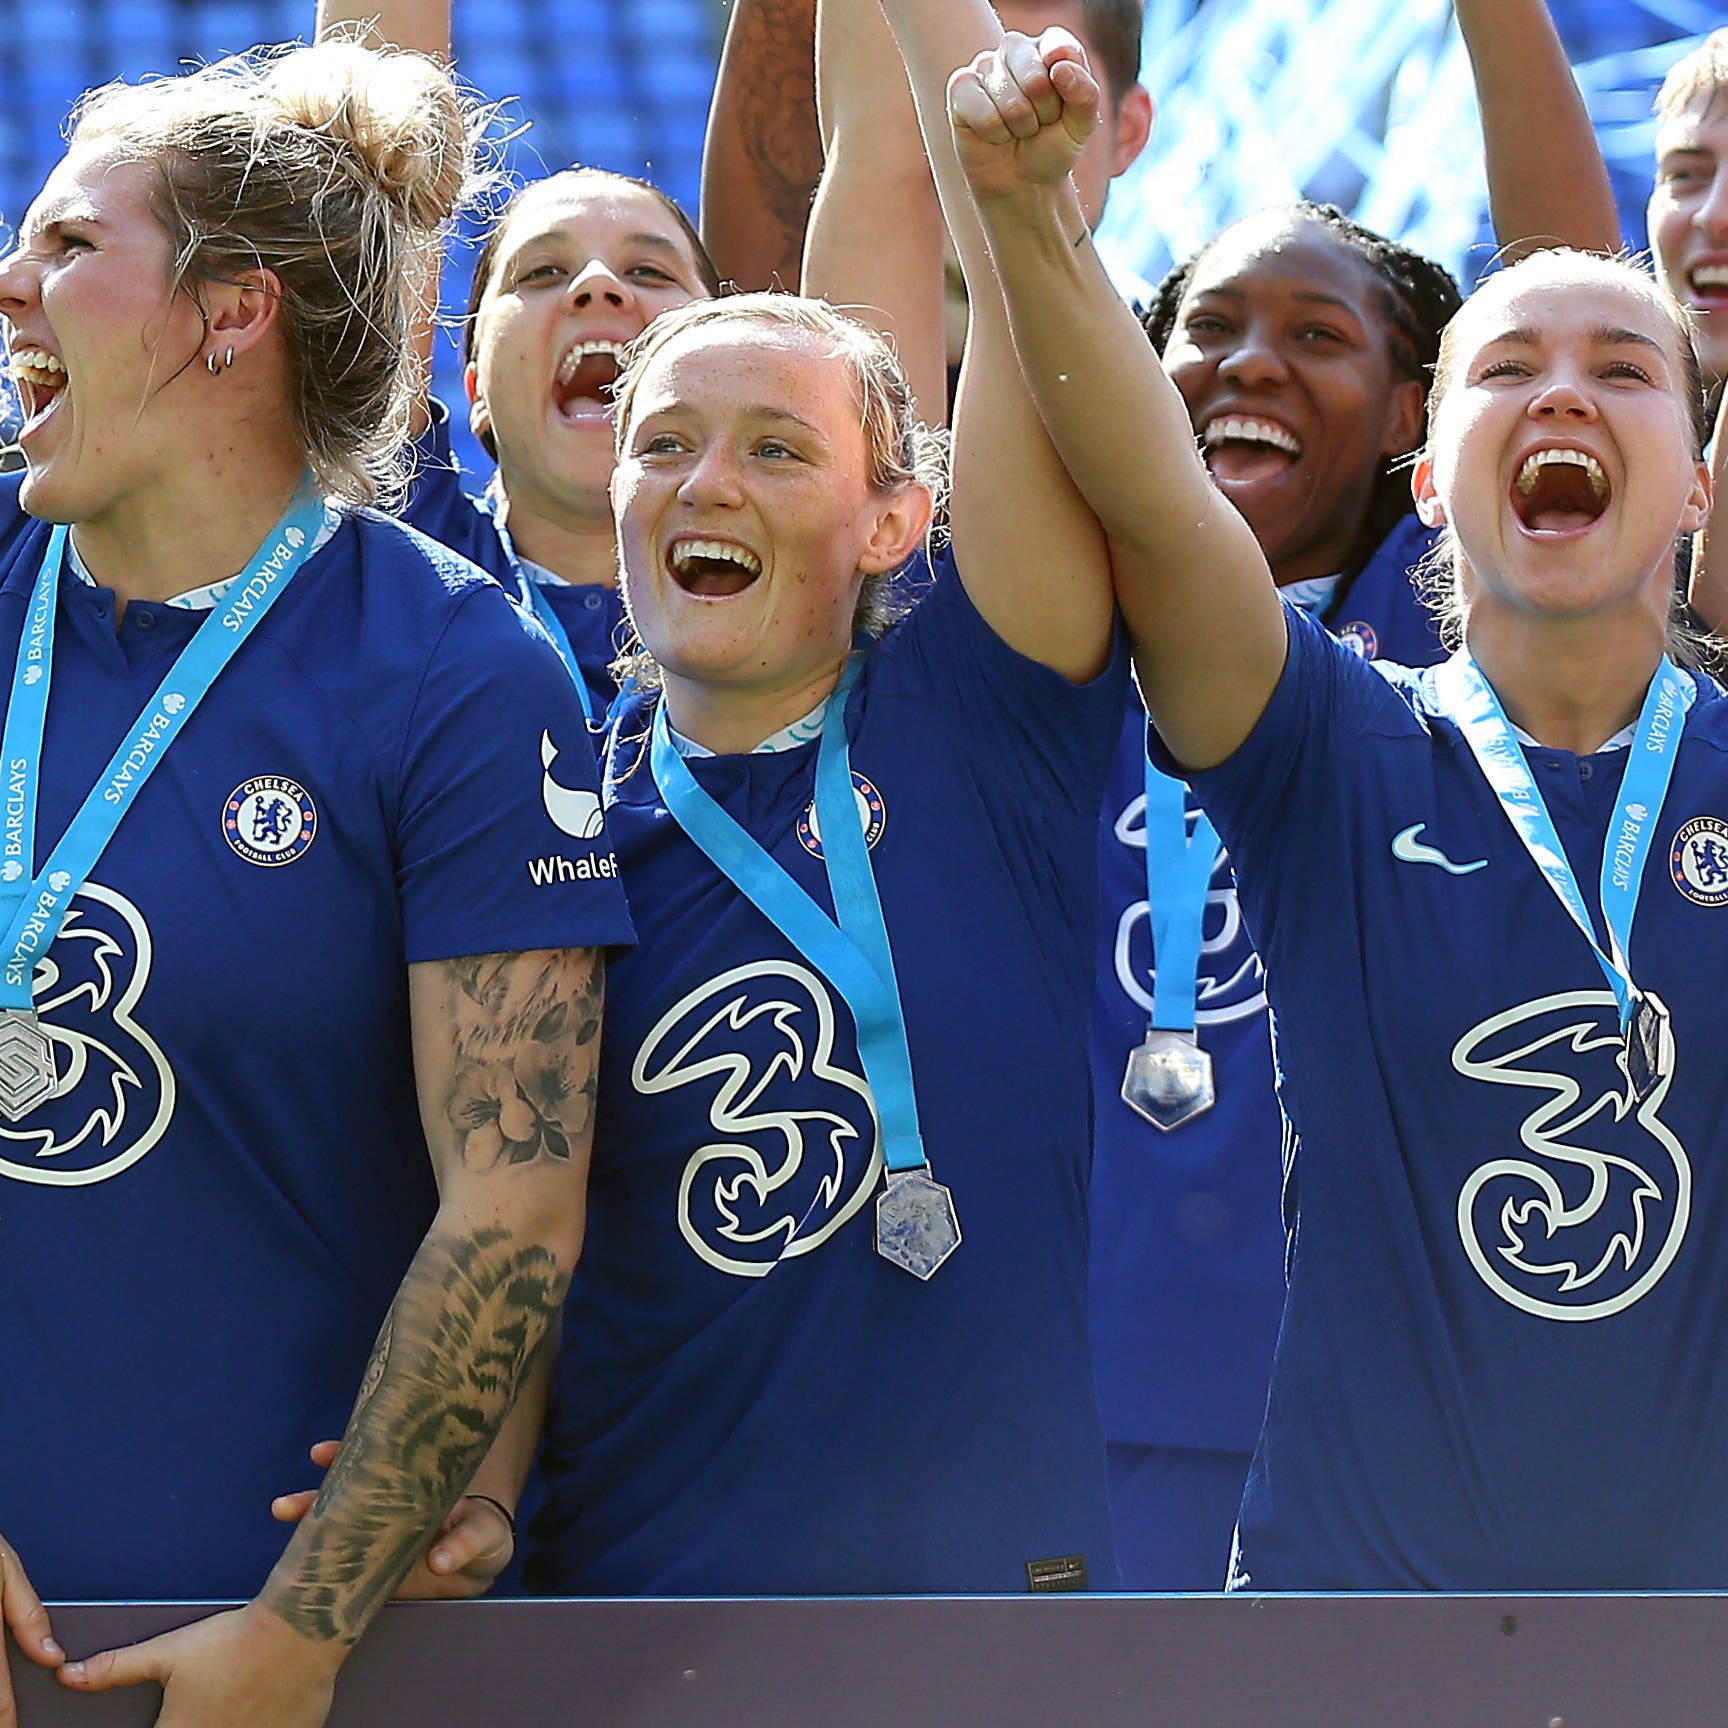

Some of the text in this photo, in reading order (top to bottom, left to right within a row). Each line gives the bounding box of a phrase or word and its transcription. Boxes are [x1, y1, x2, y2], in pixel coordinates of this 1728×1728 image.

[28, 568, 52, 660] BARCLAYS
[222, 547, 294, 632] BARCLAYS
[104, 712, 170, 805] BARCLAYS
[244, 779, 304, 802] CHELSEA
[4, 759, 28, 856] BARCLAYS
[234, 839, 296, 861] FOOTBALL CLUB
[1613, 821, 1643, 891] BARCLAYS
[7, 890, 58, 985] BARCLAYS
